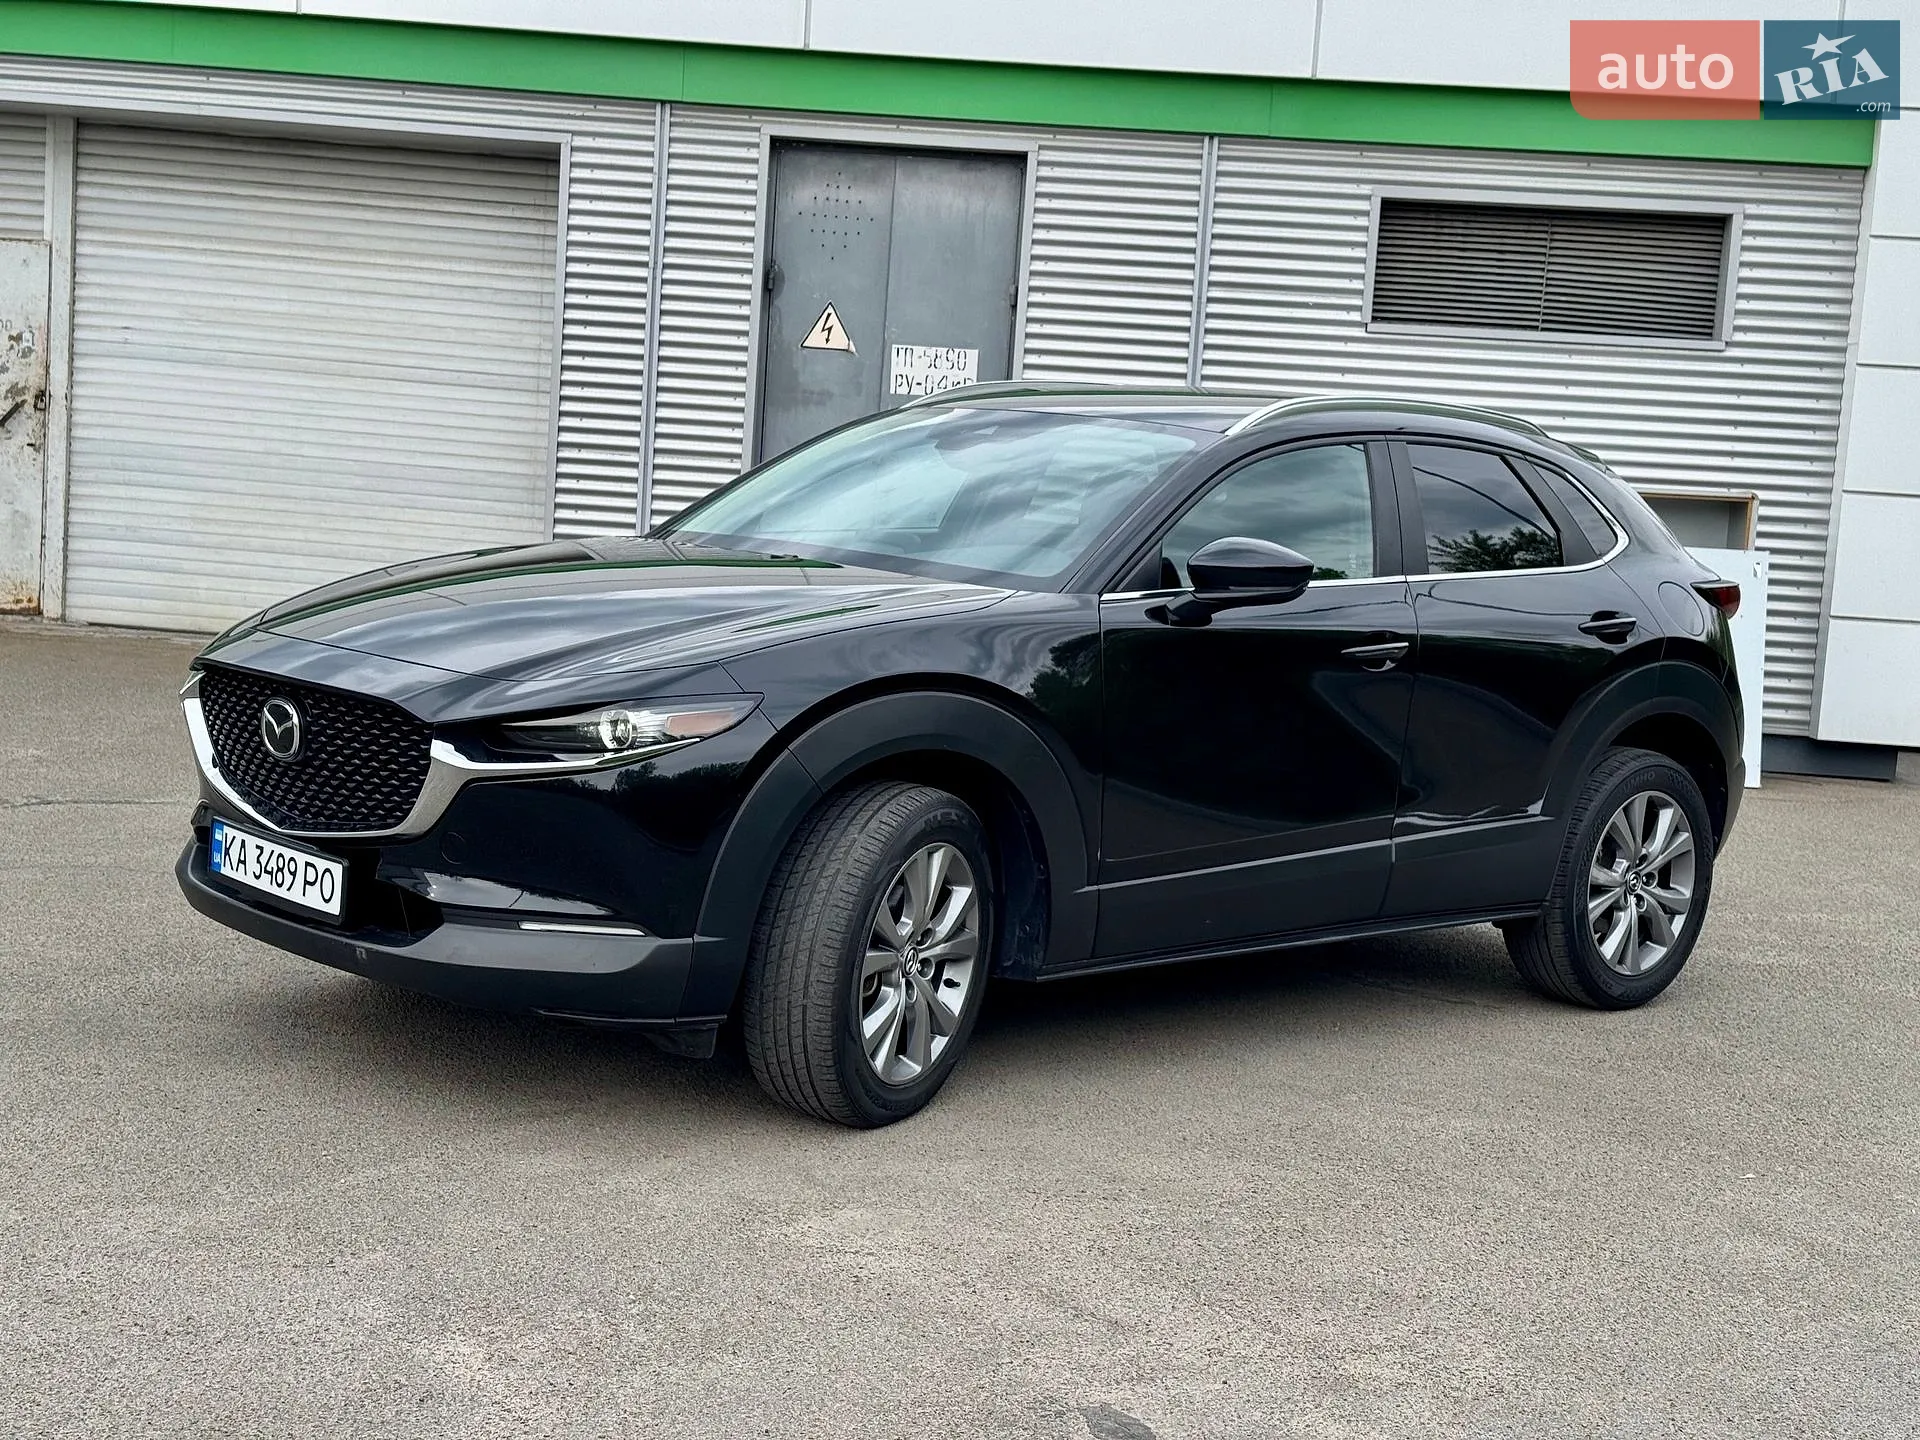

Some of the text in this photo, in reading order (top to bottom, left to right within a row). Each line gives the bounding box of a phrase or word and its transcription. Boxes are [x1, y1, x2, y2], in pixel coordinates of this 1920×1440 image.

[223, 832, 335, 904] KA 3489 PO
